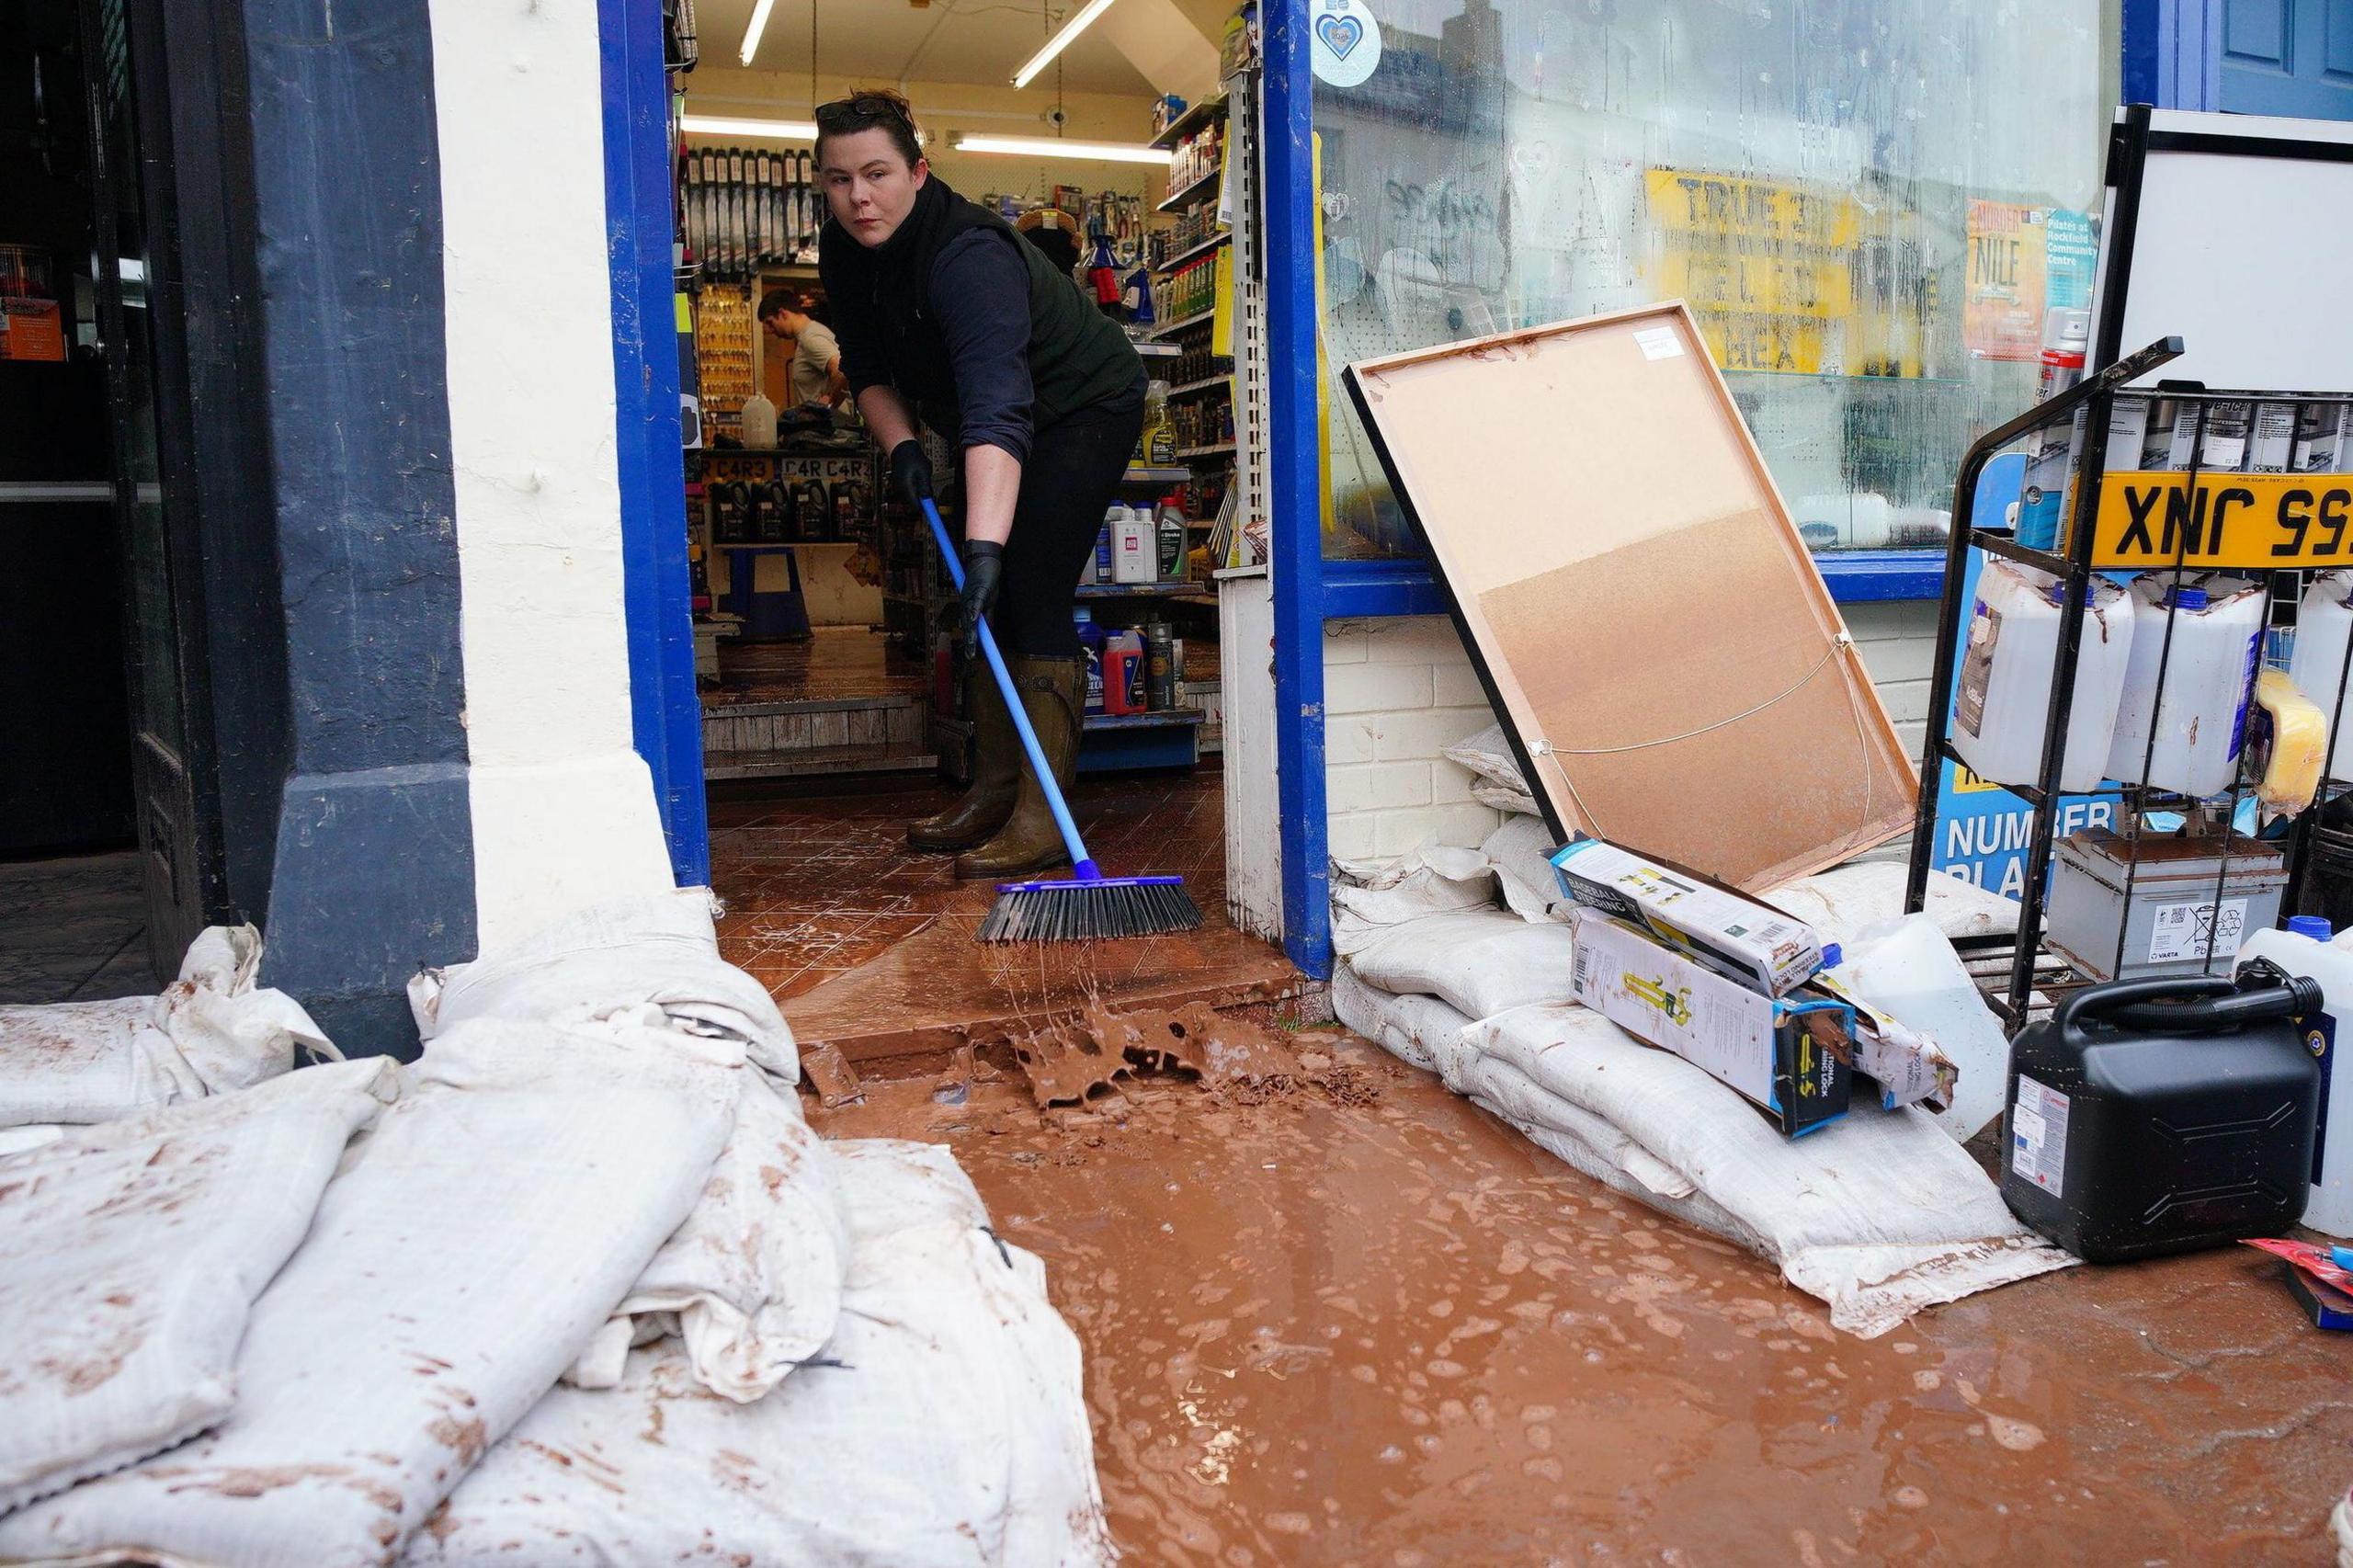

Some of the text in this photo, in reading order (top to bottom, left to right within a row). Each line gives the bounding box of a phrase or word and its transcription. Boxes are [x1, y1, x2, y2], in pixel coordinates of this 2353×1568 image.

[2048, 218, 2089, 232] Pilates at
[2048, 231, 2089, 244] Rockfield
[2048, 243, 2097, 258] Community
[1975, 236, 2020, 287] NILE
[2048, 255, 2077, 267] Centre
[2115, 486, 2353, 557] 55 JNX
[1567, 877, 1621, 902] BASEBALL
[1574, 890, 1626, 912] STEERING
[2194, 946, 2207, 955] Pb
[1827, 1053, 1836, 1087] TIONAL
